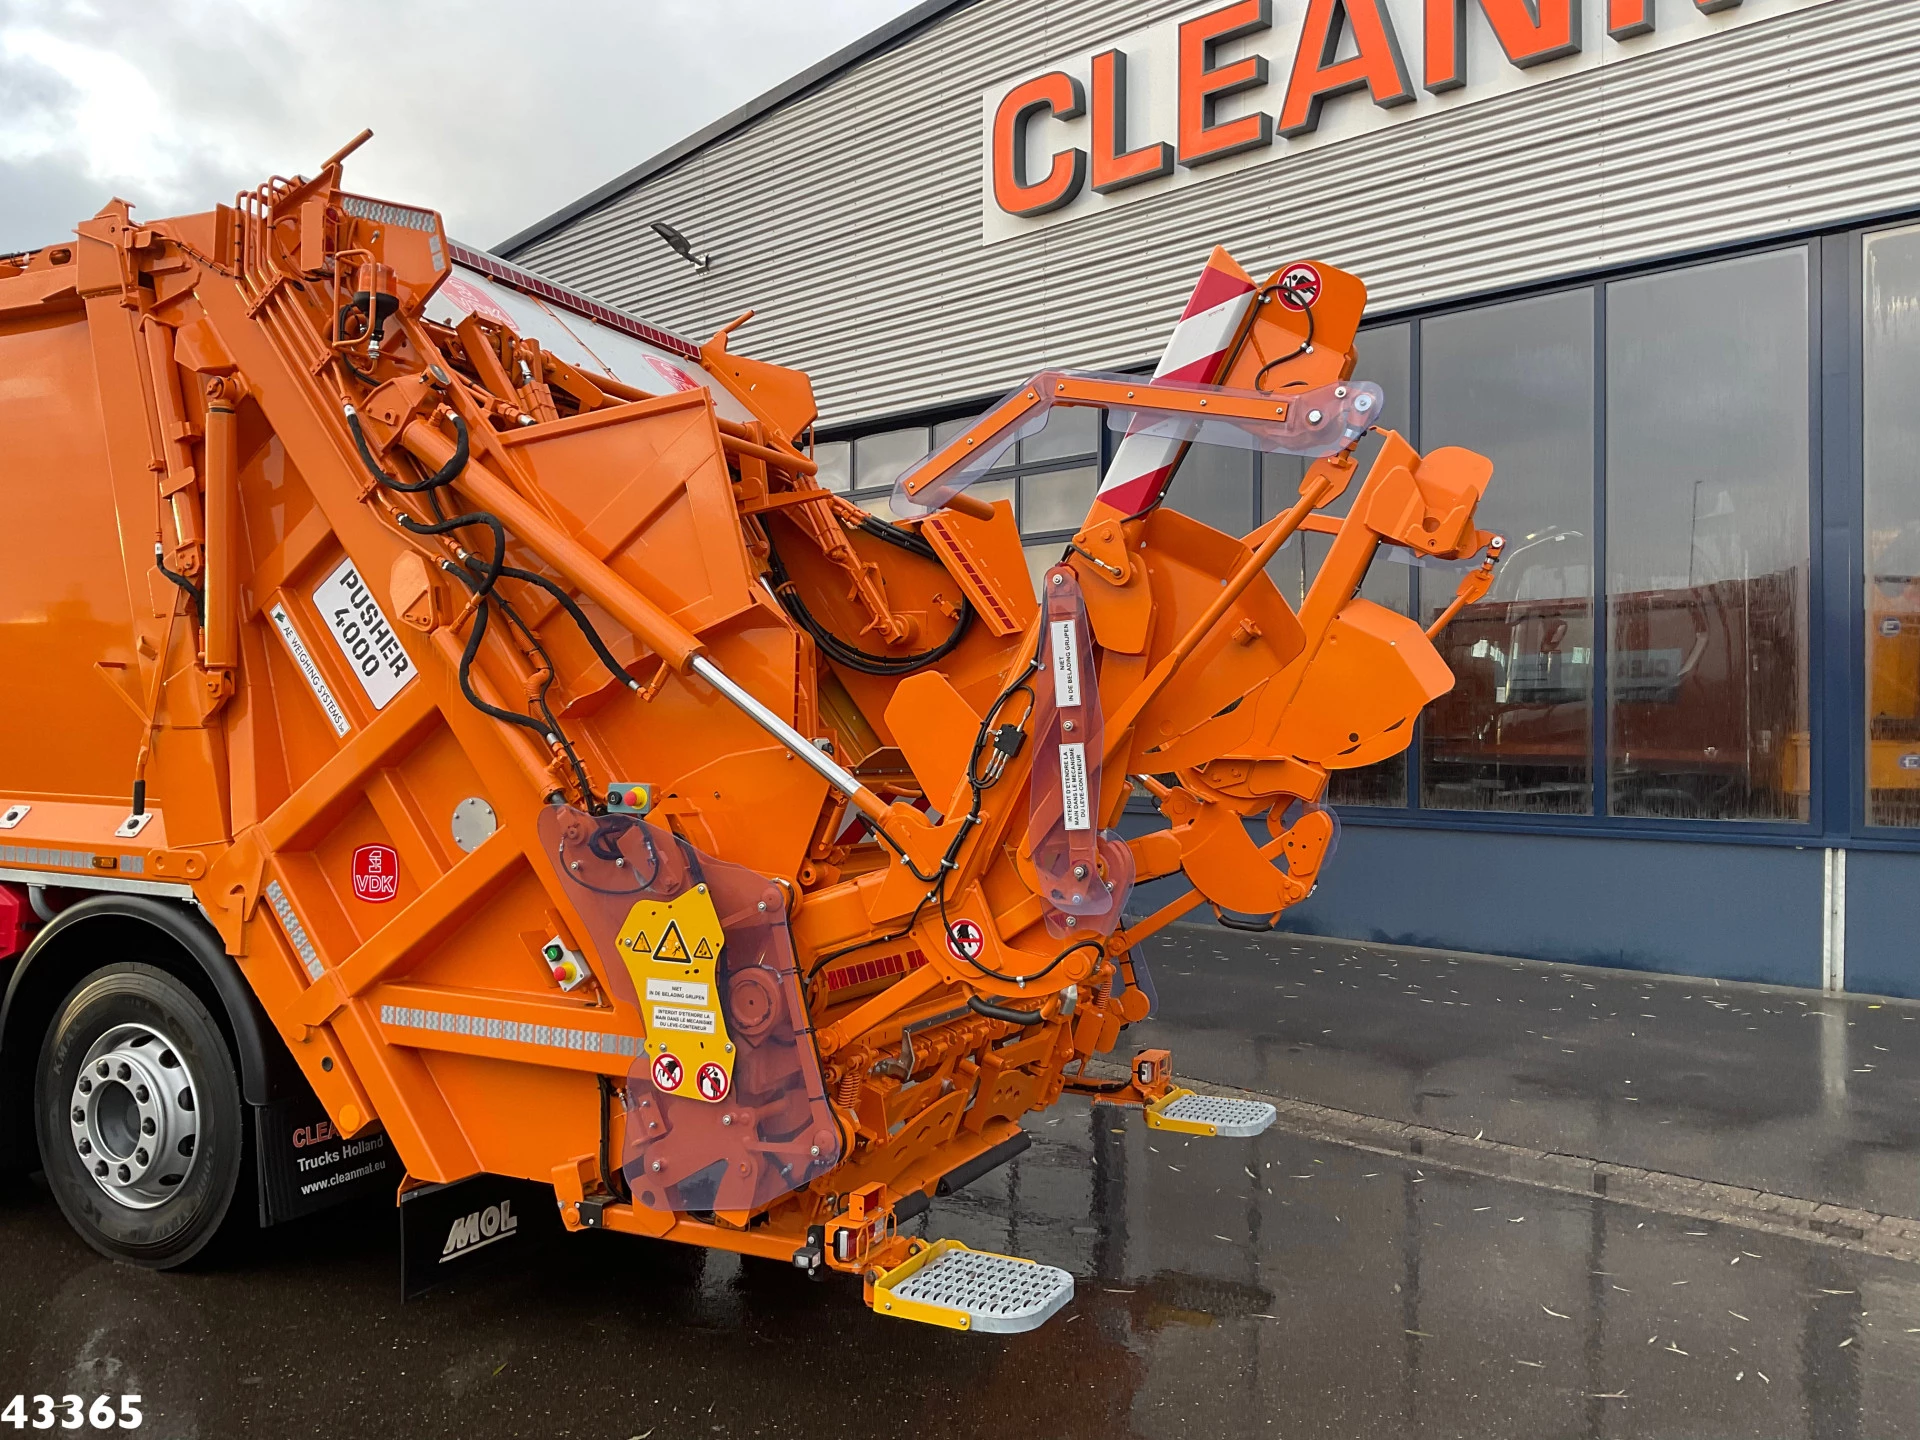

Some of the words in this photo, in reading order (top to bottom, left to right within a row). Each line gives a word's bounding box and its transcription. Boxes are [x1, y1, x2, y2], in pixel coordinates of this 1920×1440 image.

[993, 0, 1743, 218] CLEAN
[339, 568, 409, 679] PUSHER
[334, 607, 380, 677] 4000
[283, 626, 294, 639] AE
[291, 637, 320, 686] WEIGHING
[317, 685, 342, 724] SYSTEMS
[1068, 685, 1073, 694] DE
[1063, 751, 1069, 760] LA
[1069, 747, 1077, 783] MECANISME
[1072, 784, 1077, 792] LE
[1076, 754, 1084, 808] LEVE-CONTENEUR
[1080, 808, 1086, 818] DU
[355, 874, 394, 893] VDK
[661, 991, 684, 999] BELADING
[297, 1151, 340, 1172] Trucks
[342, 1134, 384, 1159] Holland
[300, 1160, 386, 1195] www.cleanmat.eu
[442, 1199, 518, 1256] MOL
